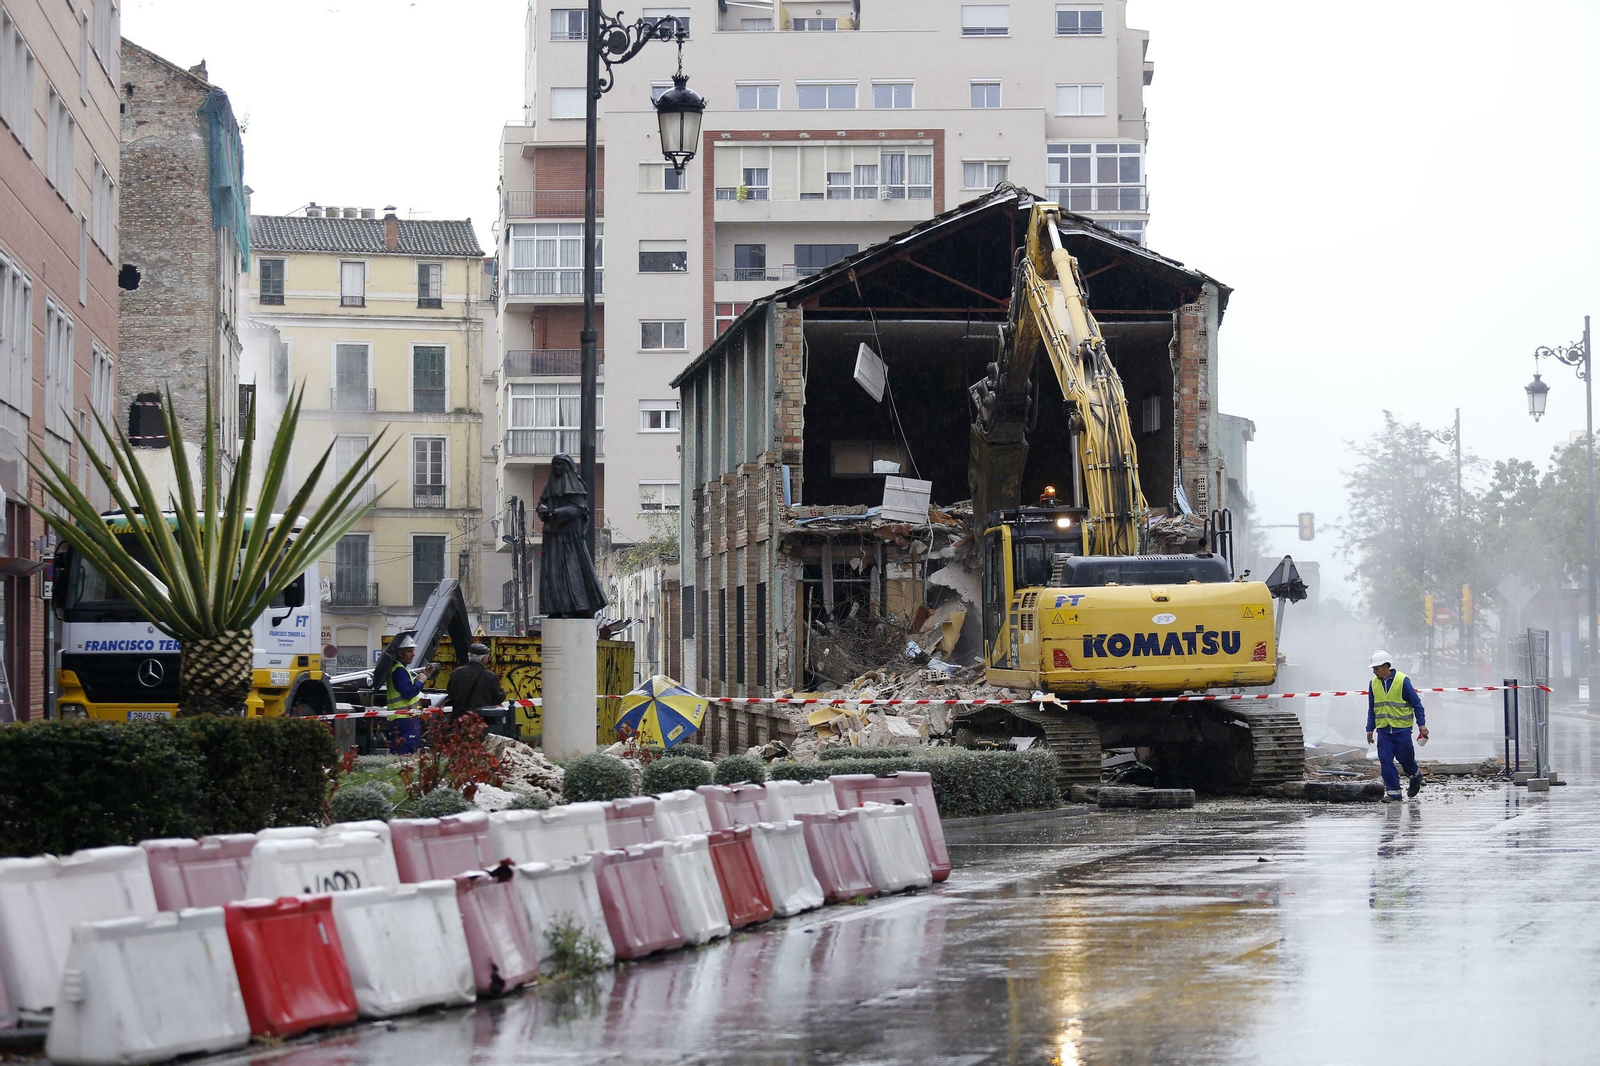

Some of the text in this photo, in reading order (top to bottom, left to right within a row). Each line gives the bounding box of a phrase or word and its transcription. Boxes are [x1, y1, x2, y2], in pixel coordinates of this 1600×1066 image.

[295, 615, 309, 627] FT
[84, 640, 154, 651] FRANCISCO
[1083, 625, 1241, 658] KOMATSU
[133, 712, 151, 721] 2840
